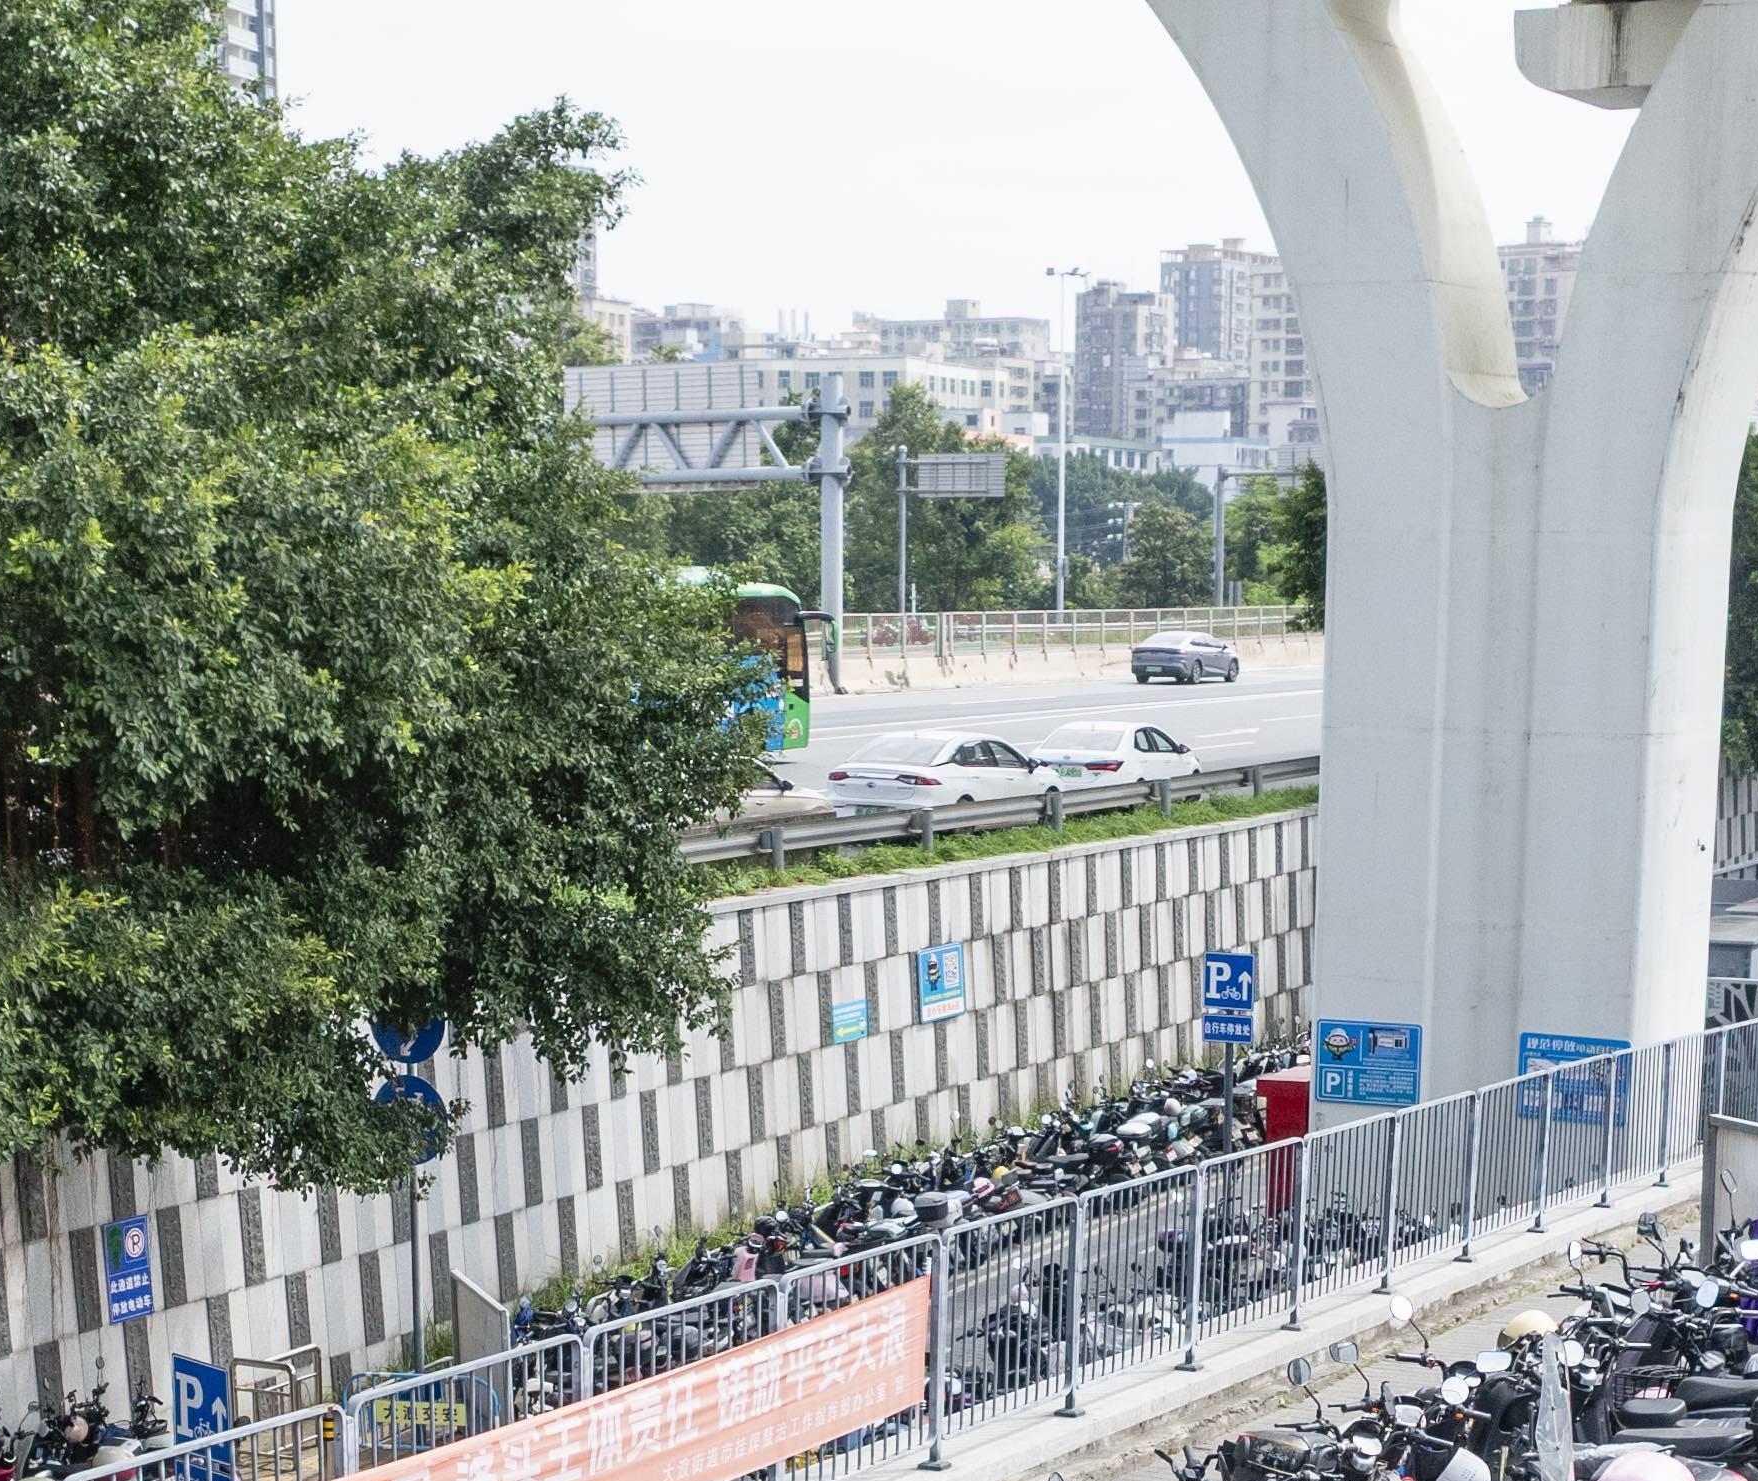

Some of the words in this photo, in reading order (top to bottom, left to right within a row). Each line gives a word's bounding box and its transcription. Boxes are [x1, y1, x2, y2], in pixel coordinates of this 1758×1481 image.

[1204, 1021, 1251, 1036] 自行车停放处
[110, 1273, 150, 1294] 此通道禁止
[112, 1294, 153, 1317] 停放电动车
